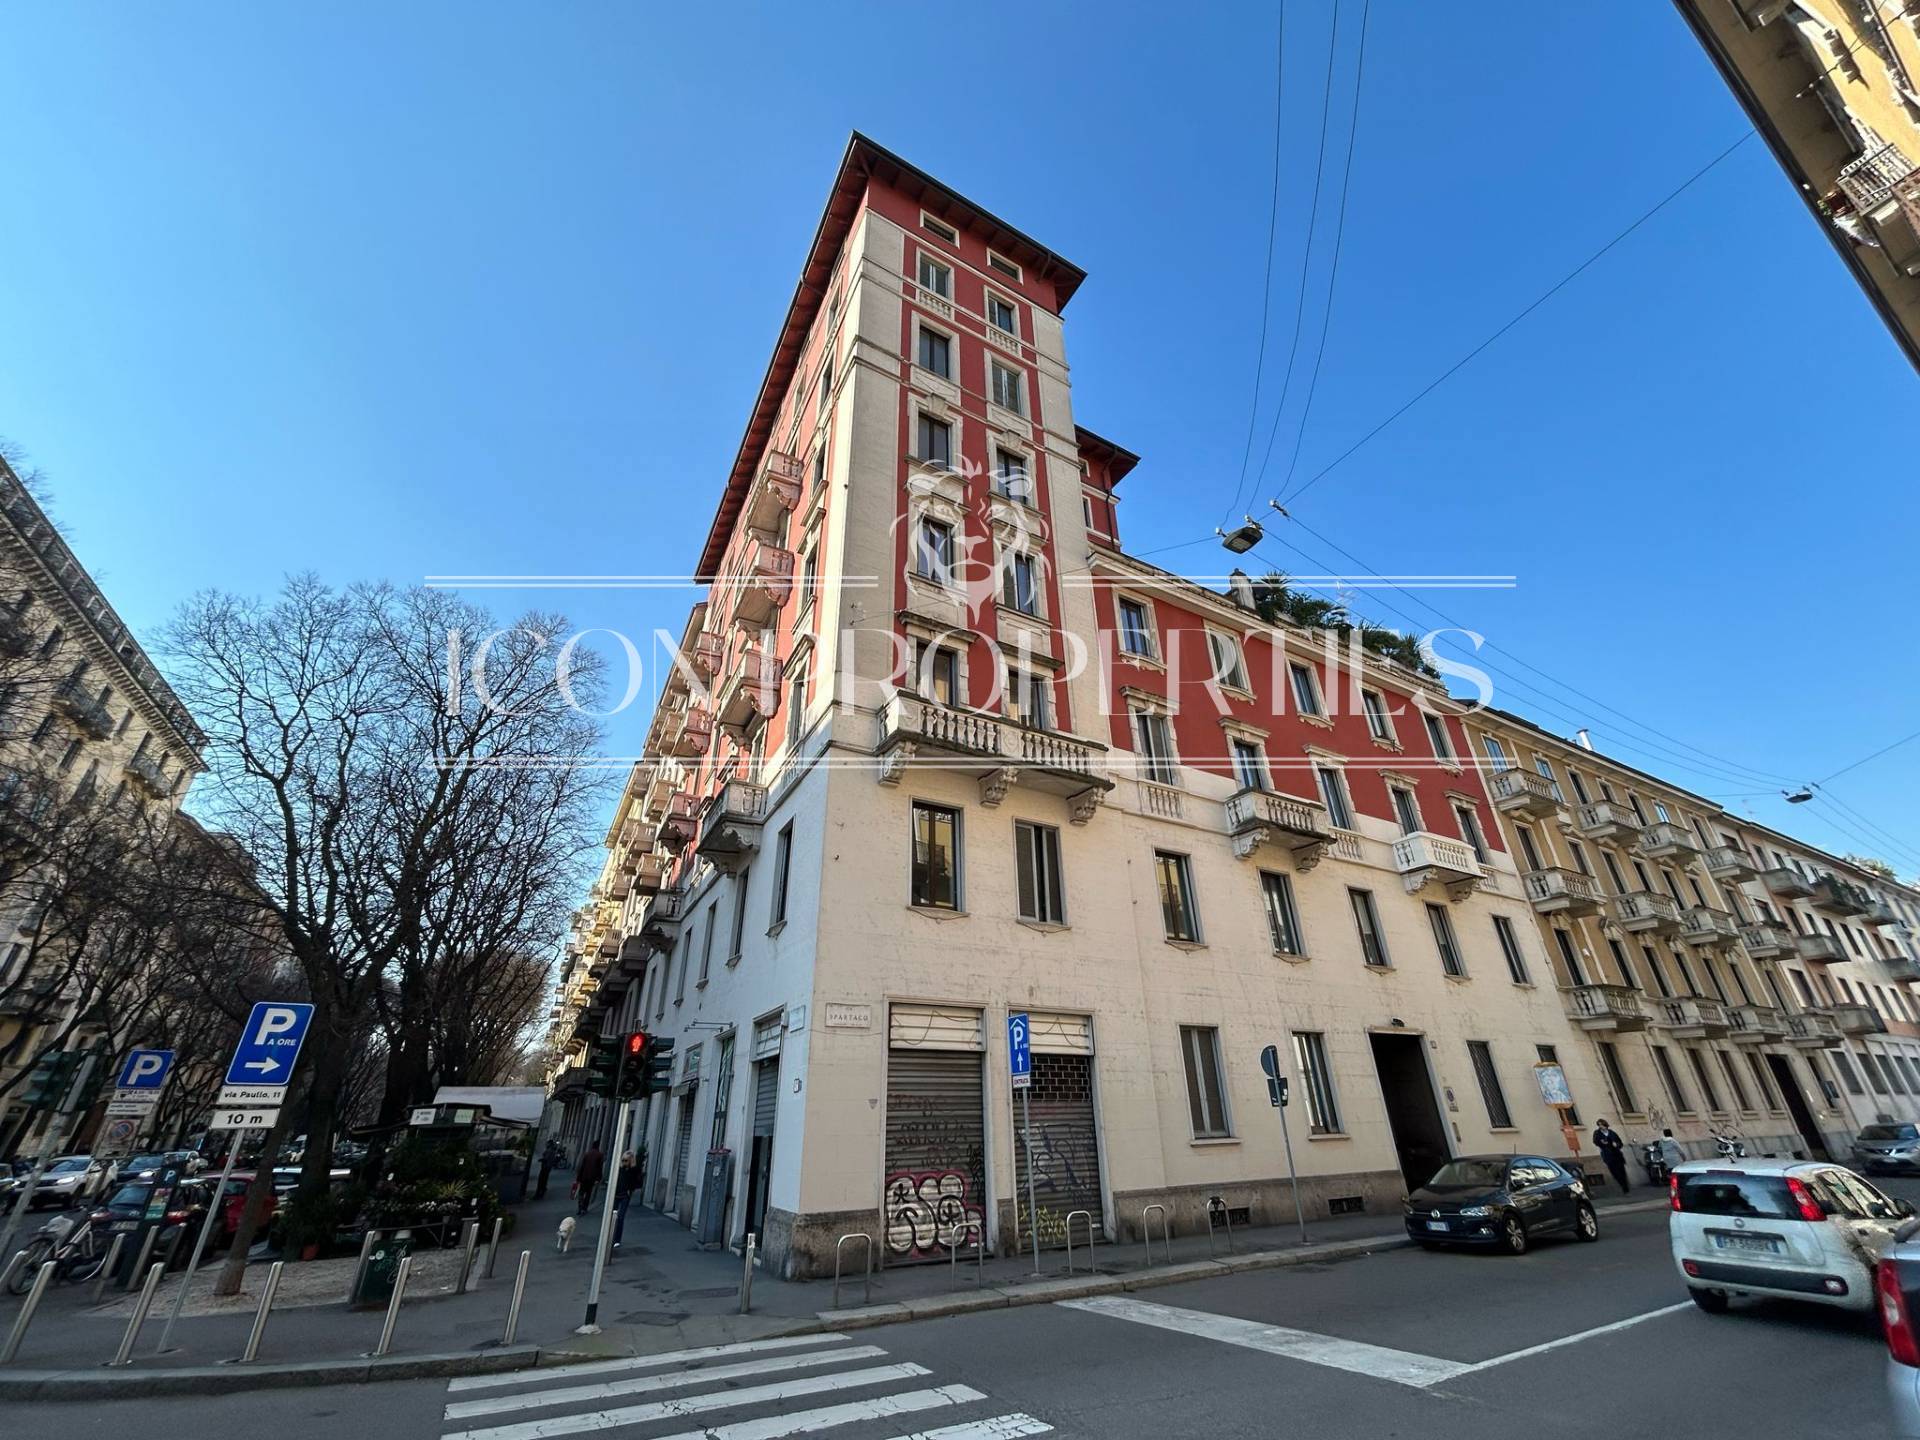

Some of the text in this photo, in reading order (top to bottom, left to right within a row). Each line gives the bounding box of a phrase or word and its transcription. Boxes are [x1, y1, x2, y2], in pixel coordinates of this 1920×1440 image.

[254, 1008, 297, 1045] P
[1013, 1026, 1024, 1050] P
[127, 1055, 163, 1085] P
[227, 1114, 263, 1124] 10 m
